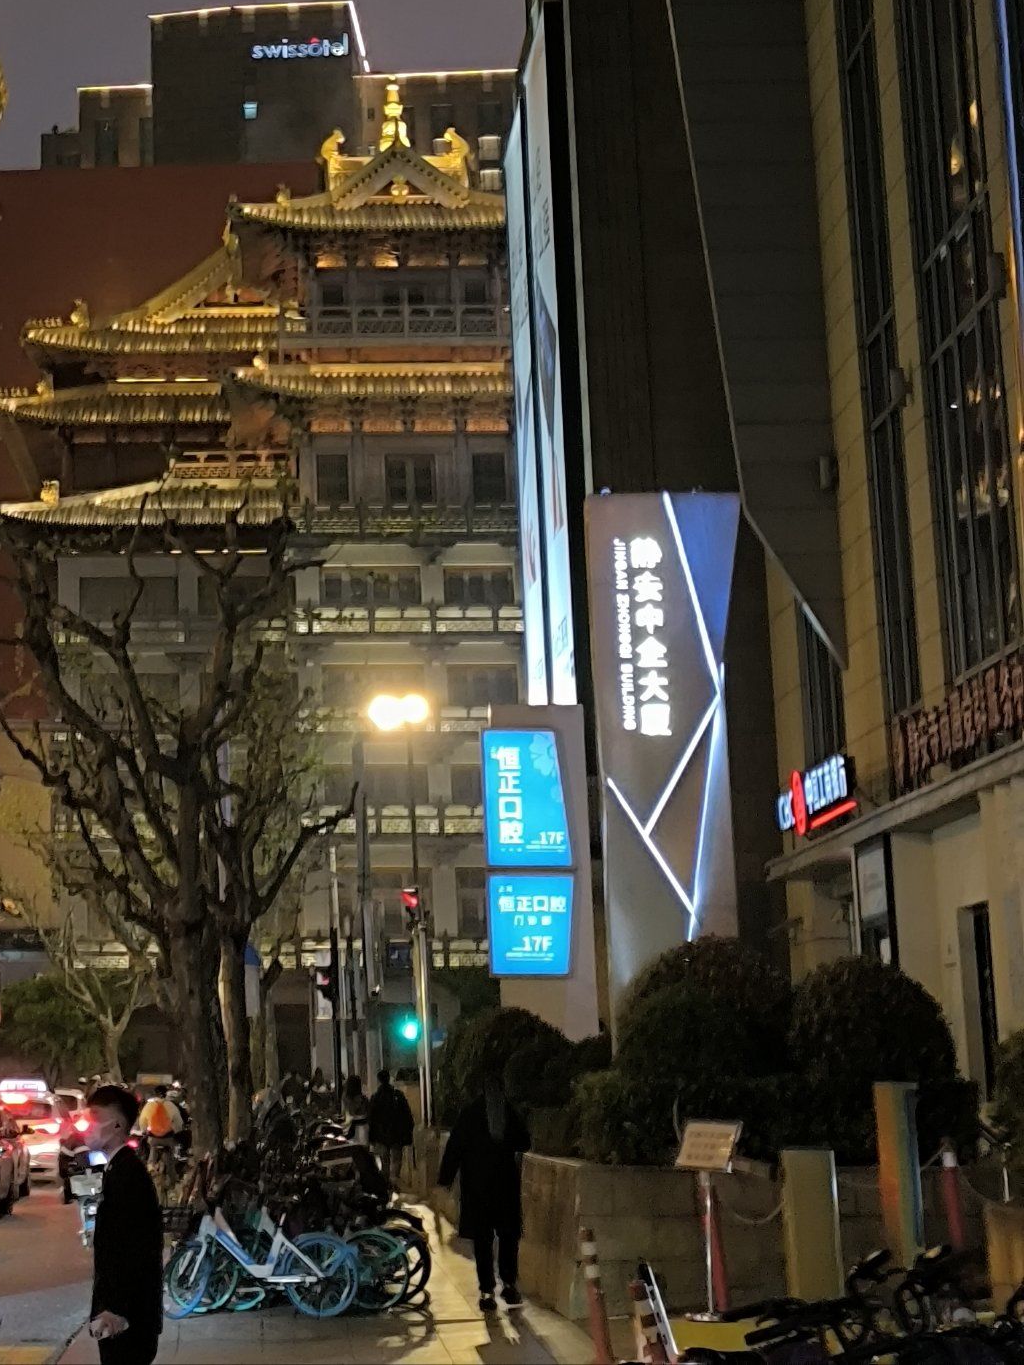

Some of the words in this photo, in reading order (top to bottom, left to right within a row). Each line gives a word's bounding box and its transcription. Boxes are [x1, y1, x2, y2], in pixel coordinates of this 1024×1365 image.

[613, 537, 629, 590] JINGAN
[620, 663, 637, 731] BUILDING
[538, 831, 565, 845] 17F
[498, 895, 567, 913] 恒正口腔
[522, 935, 553, 952] 17F
